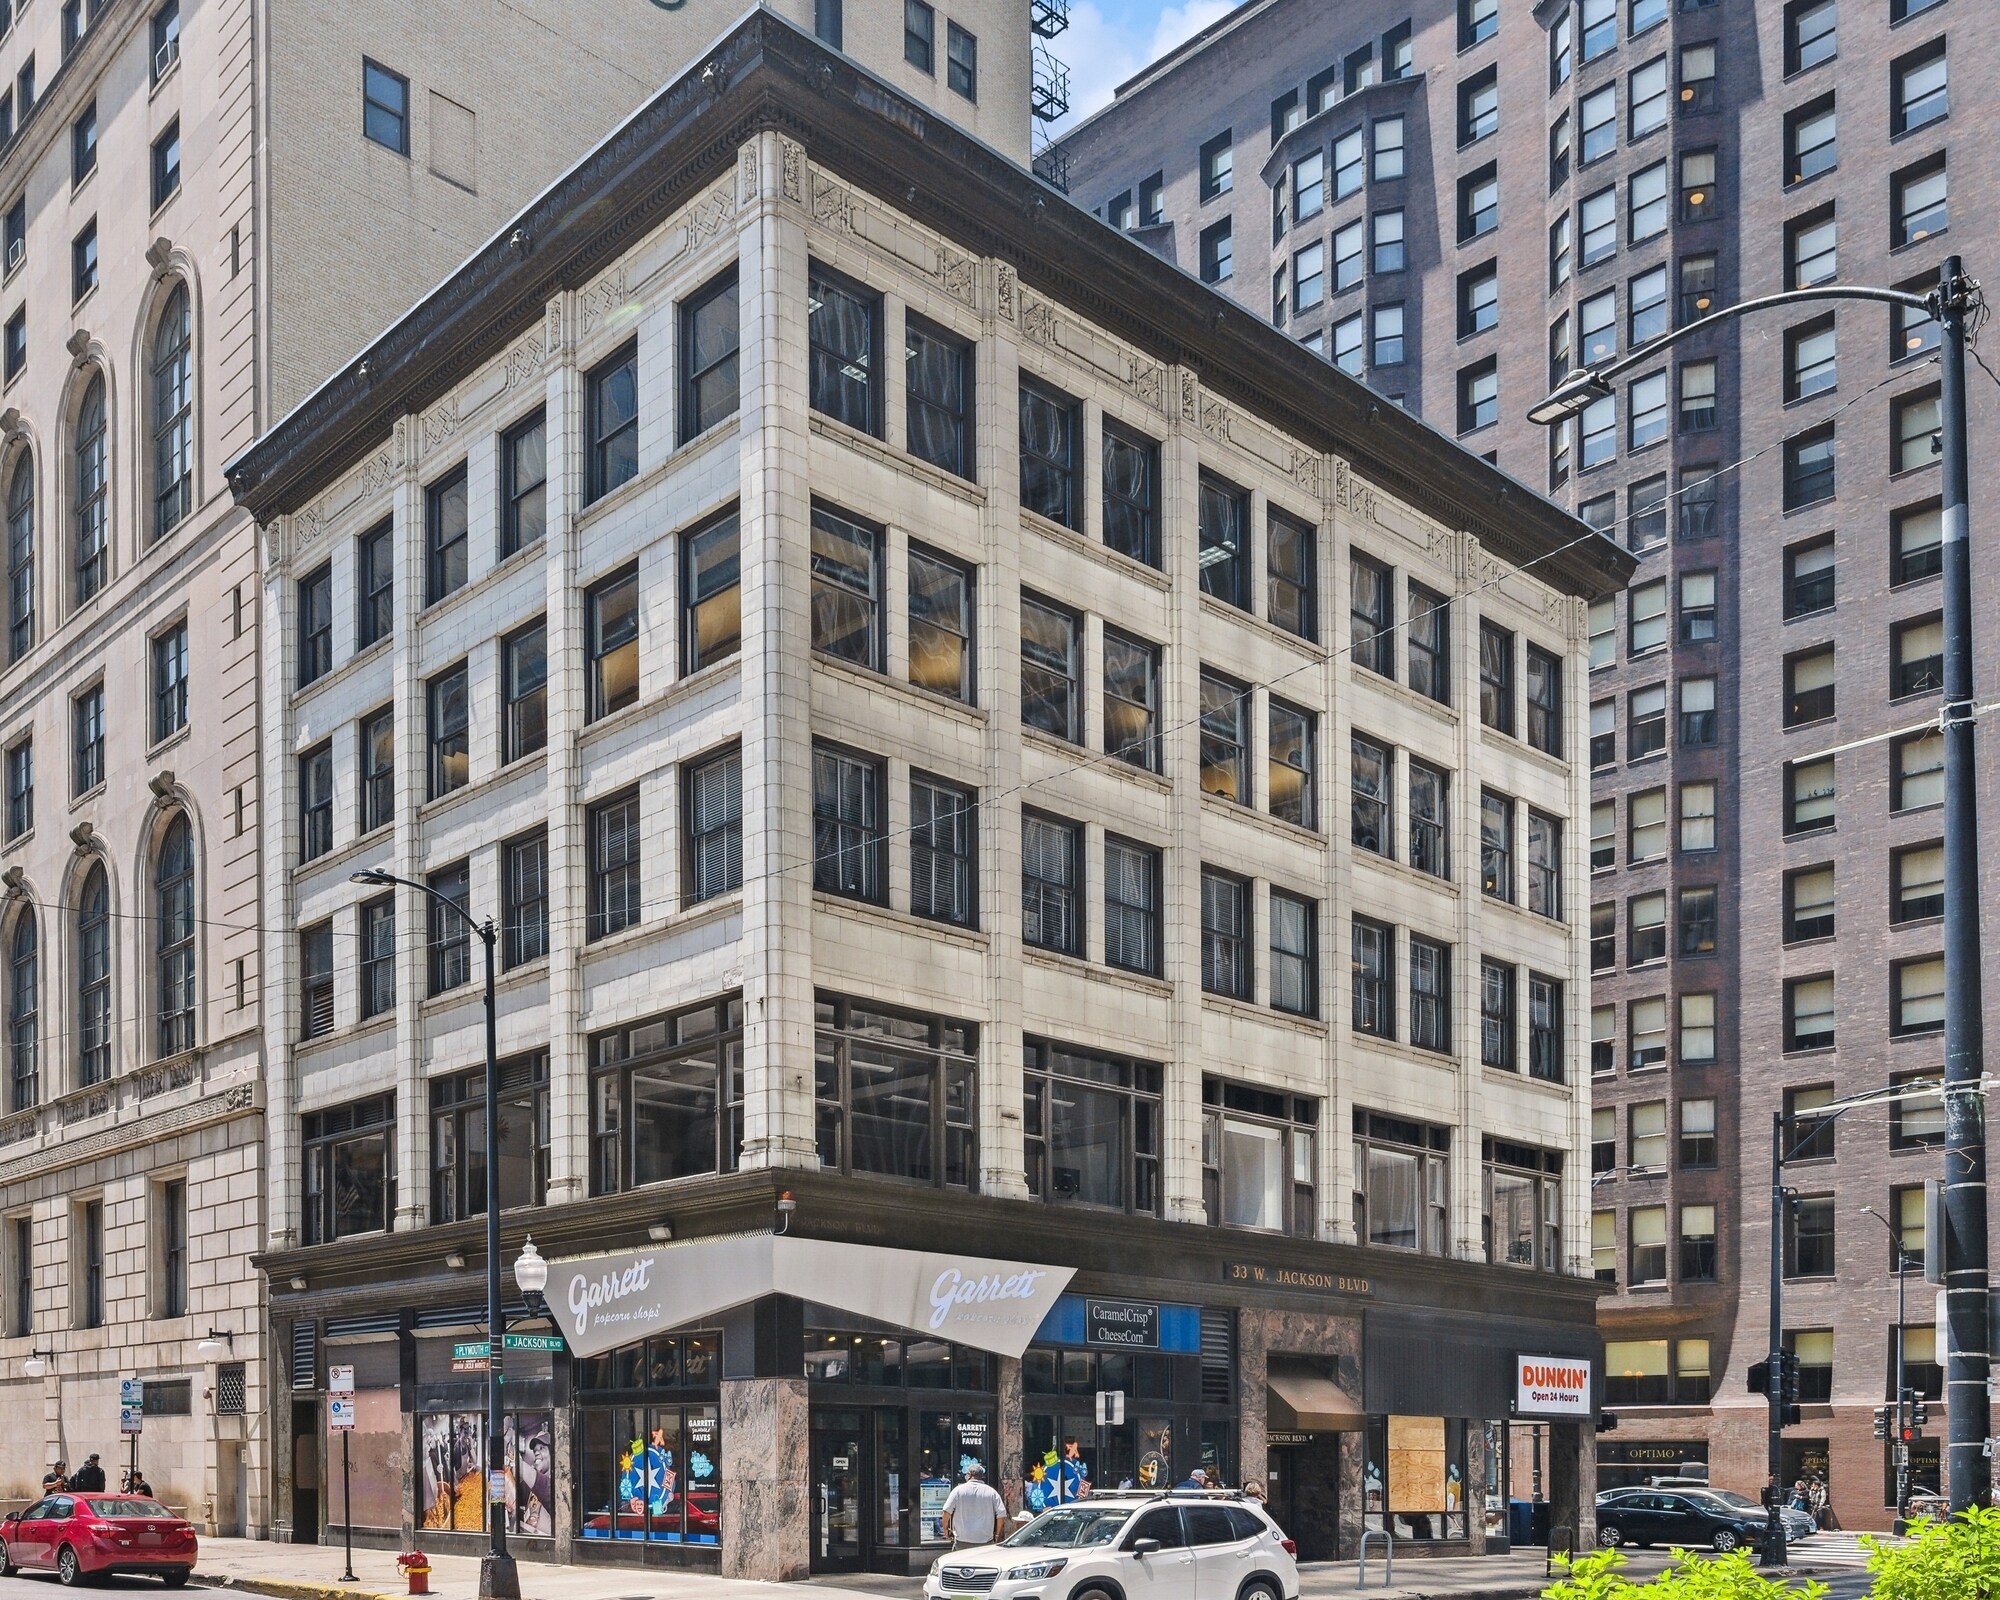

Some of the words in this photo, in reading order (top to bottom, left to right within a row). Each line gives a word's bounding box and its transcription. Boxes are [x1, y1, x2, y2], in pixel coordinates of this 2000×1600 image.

[1232, 1265, 1248, 1279] 33
[1254, 1267, 1269, 1281] W.
[1276, 1270, 1332, 1288] JACKSON
[568, 1258, 655, 1336] Garrett
[928, 1267, 1047, 1330] Garrett
[593, 1312, 630, 1326] popcorn
[512, 1337, 548, 1349] JACKSON
[458, 1345, 484, 1356] PLYMOUTH
[1522, 1365, 1588, 1389] DUNKIN'
[1531, 1391, 1549, 1402] Open
[1549, 1392, 1558, 1401] 24
[1559, 1392, 1579, 1402] Hours
[688, 1419, 715, 1427] GARRETT
[957, 1423, 987, 1431] GARRETT
[692, 1434, 711, 1442] FAVES
[962, 1437, 982, 1445] FAVES
[1629, 1449, 1675, 1458] OPTIMO
